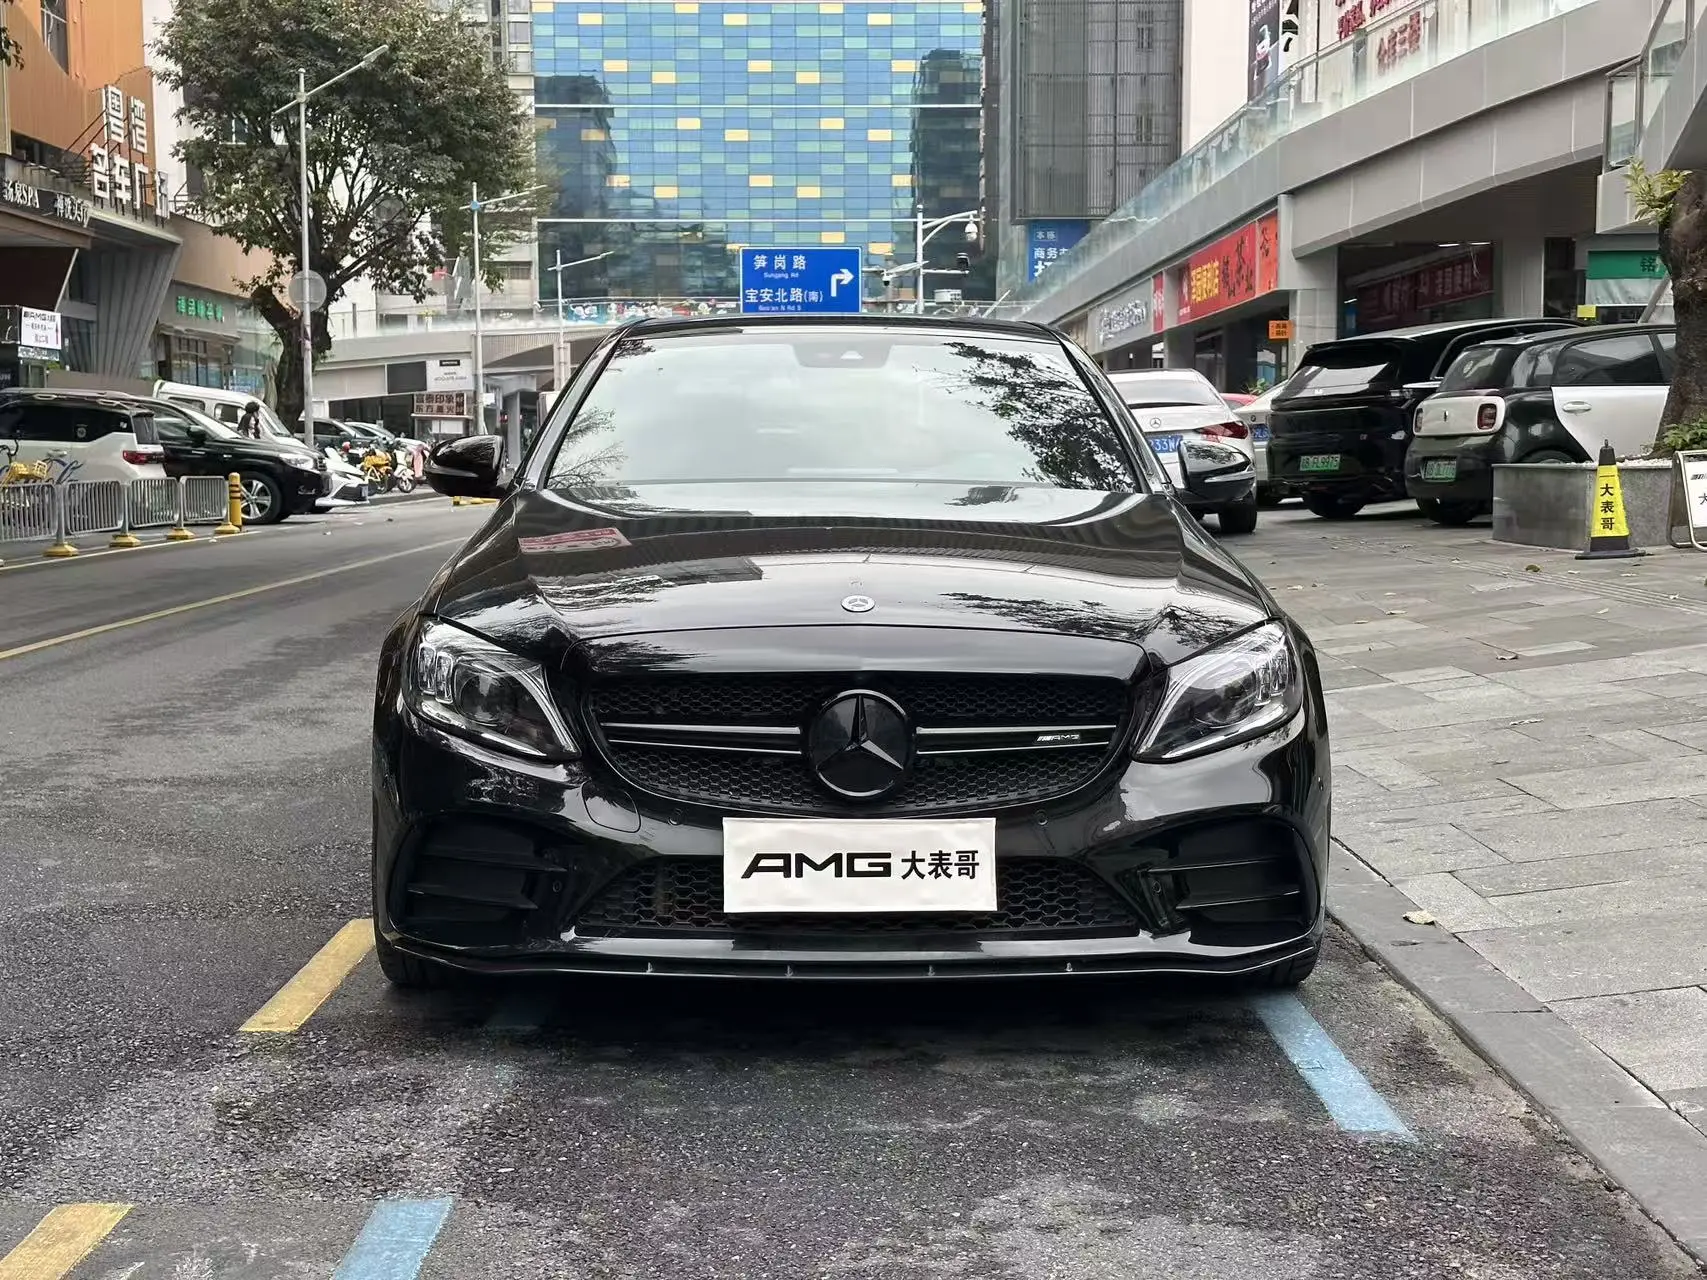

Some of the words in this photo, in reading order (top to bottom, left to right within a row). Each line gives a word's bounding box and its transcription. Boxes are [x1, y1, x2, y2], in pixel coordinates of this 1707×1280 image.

[753, 254, 806, 270] 笋岗路
[745, 287, 823, 303] 宝安北路(南)
[1600, 484, 1615, 530] 大表哥
[741, 852, 892, 878] AMG
[901, 849, 980, 880] 大表哥
